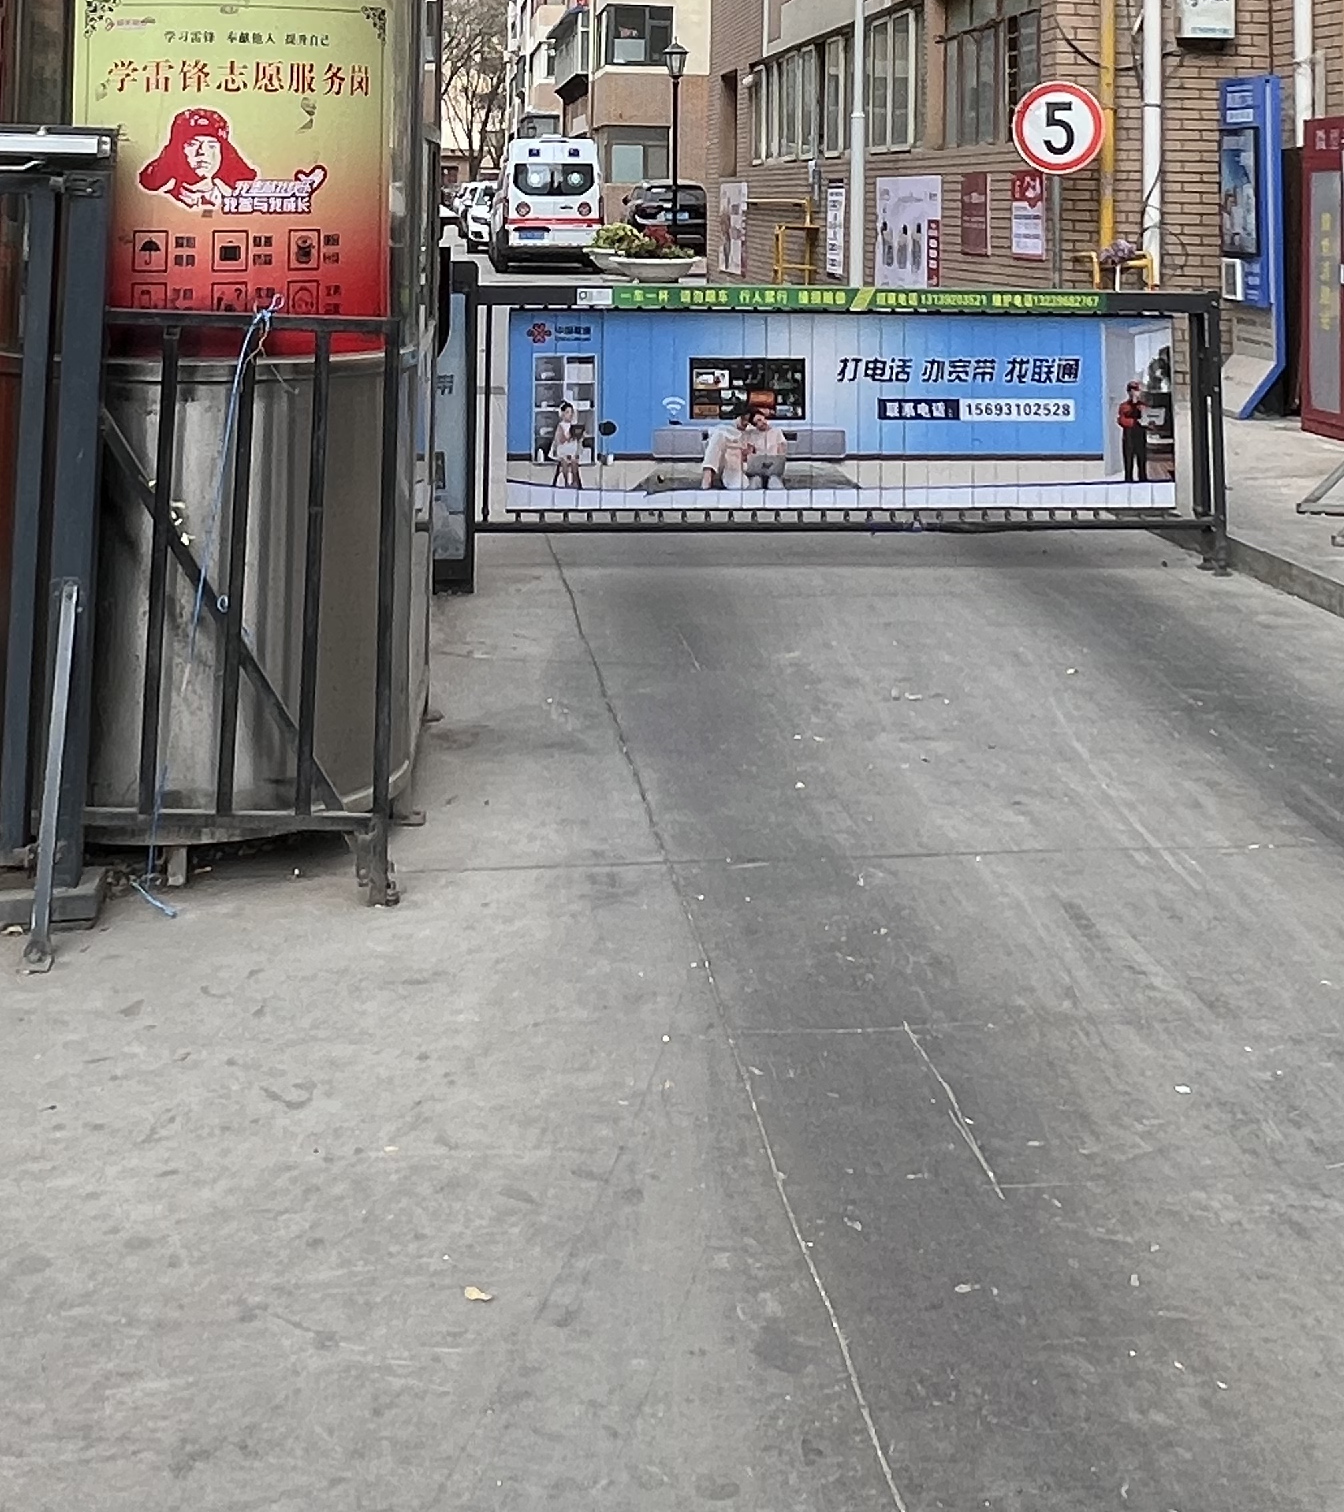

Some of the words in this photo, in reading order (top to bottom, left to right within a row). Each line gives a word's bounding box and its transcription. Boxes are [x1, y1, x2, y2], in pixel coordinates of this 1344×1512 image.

[107, 58, 371, 97] 学雷锋志愿服务岗
[1043, 100, 1076, 156] 5
[837, 356, 913, 383] 打电话
[921, 357, 997, 384] 办宽带
[1005, 356, 1081, 384] 找联通
[966, 402, 1071, 417] 15693102528
